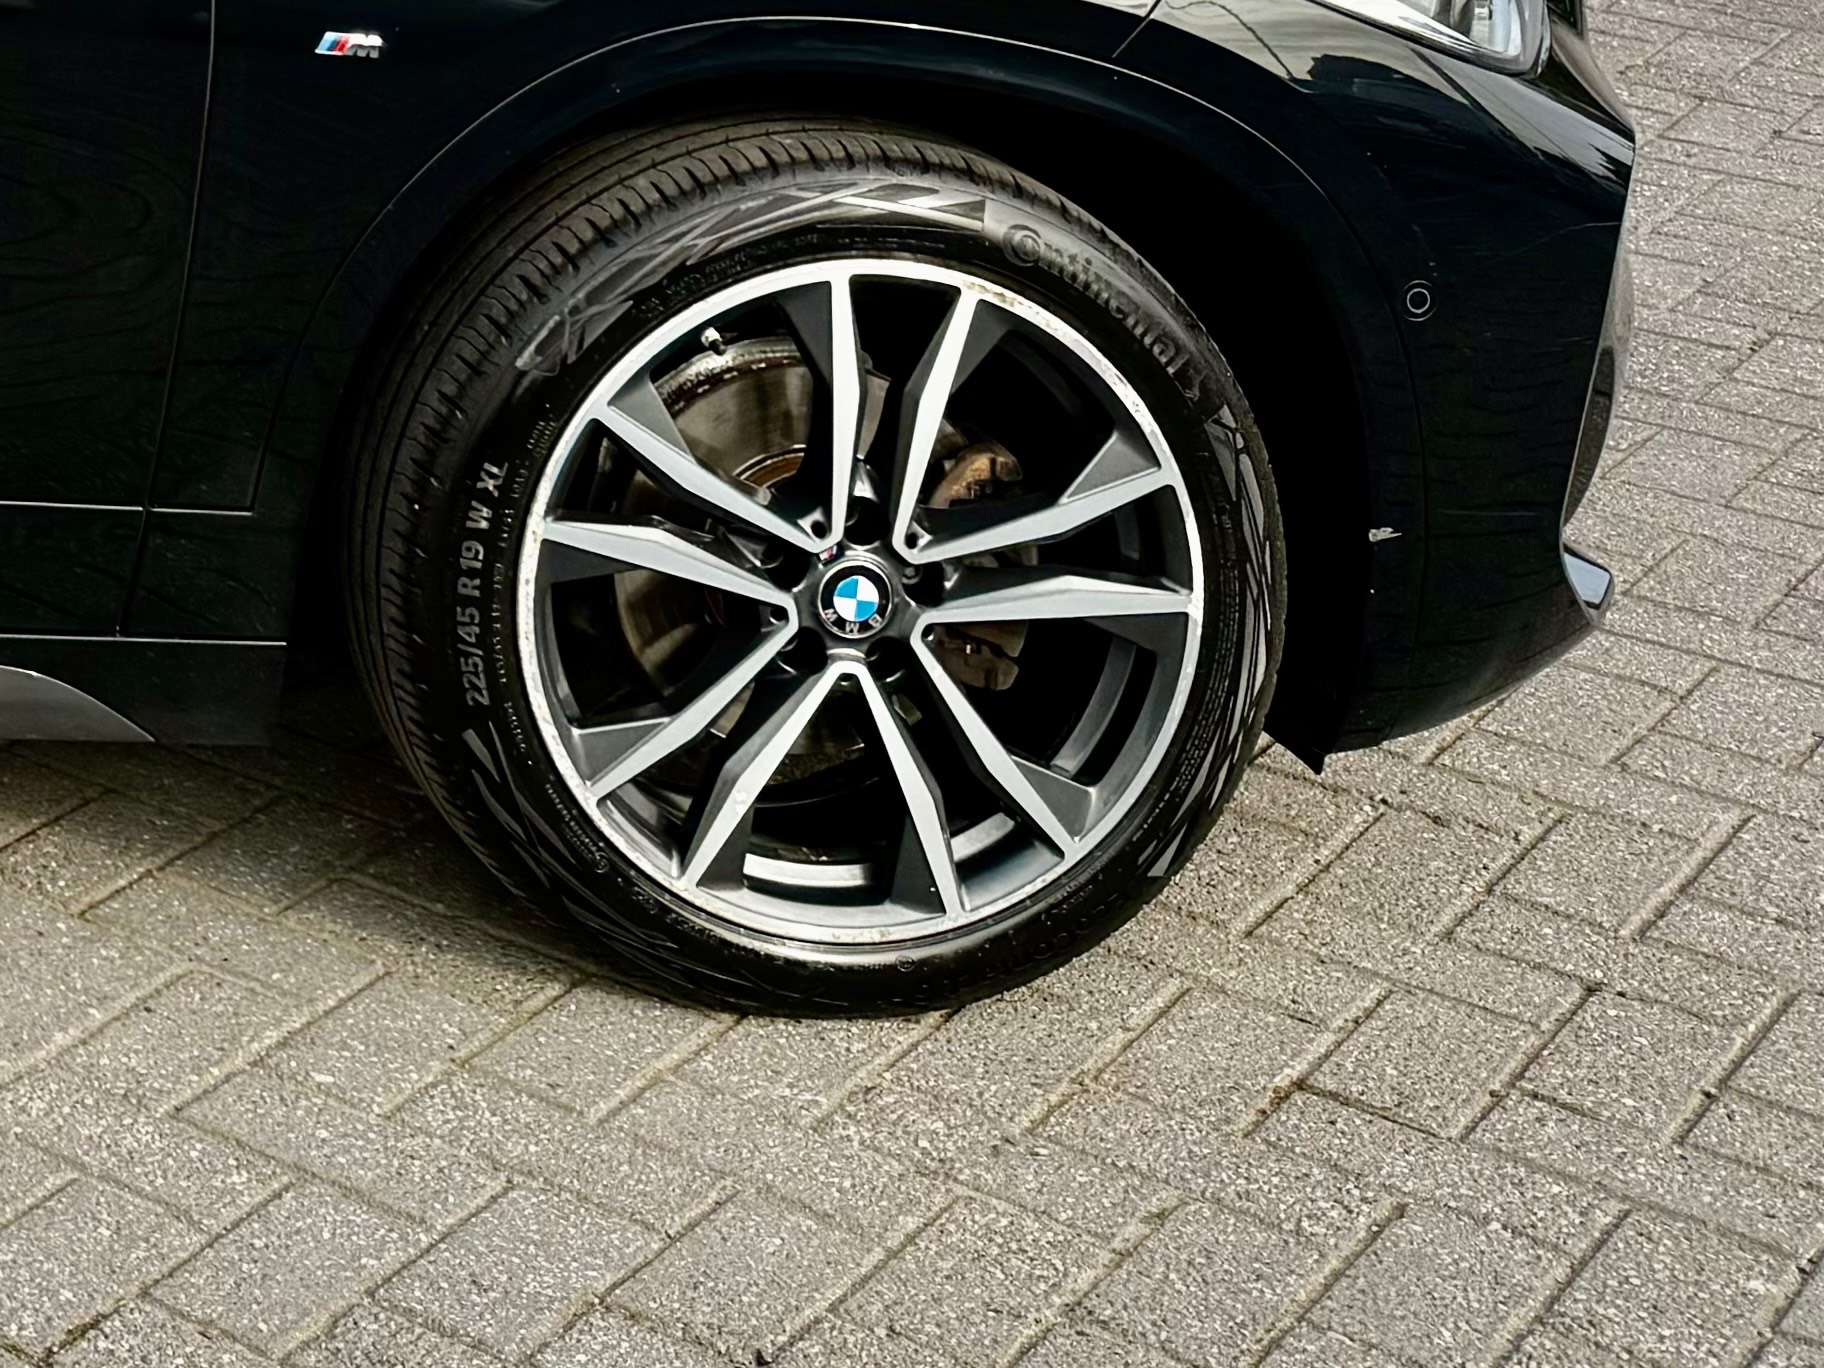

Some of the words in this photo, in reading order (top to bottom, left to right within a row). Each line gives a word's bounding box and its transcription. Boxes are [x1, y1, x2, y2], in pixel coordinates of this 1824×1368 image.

[476, 462, 508, 498] XL
[465, 500, 493, 530] W
[457, 576, 481, 598] R
[456, 606, 491, 706] 225/45
